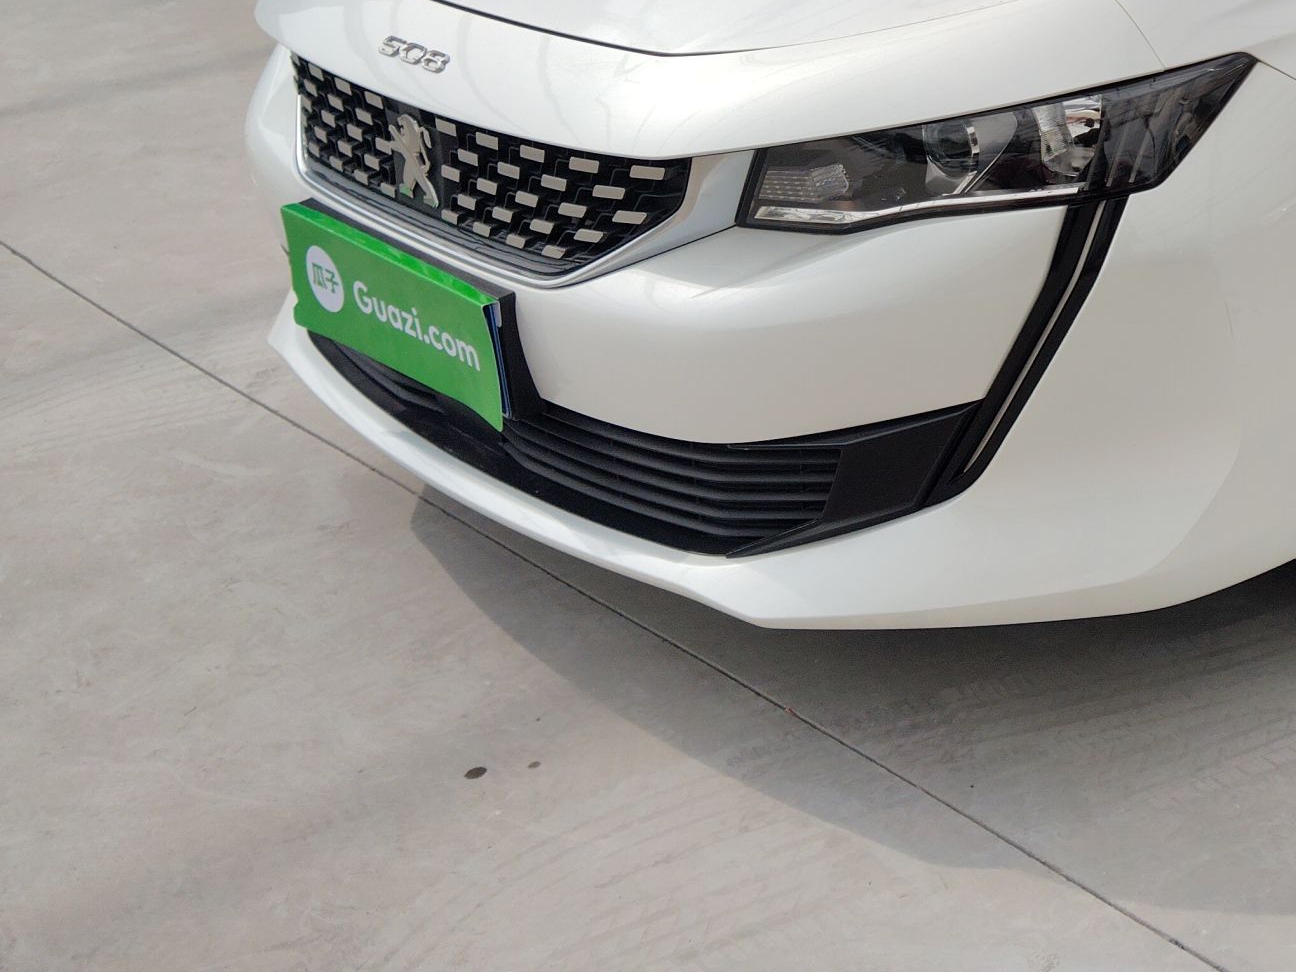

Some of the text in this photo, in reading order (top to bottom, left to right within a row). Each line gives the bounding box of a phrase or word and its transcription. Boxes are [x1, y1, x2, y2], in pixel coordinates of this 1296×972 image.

[379, 35, 450, 74] 508
[312, 262, 339, 294] 瓜子
[352, 280, 481, 372] Guazi.com
